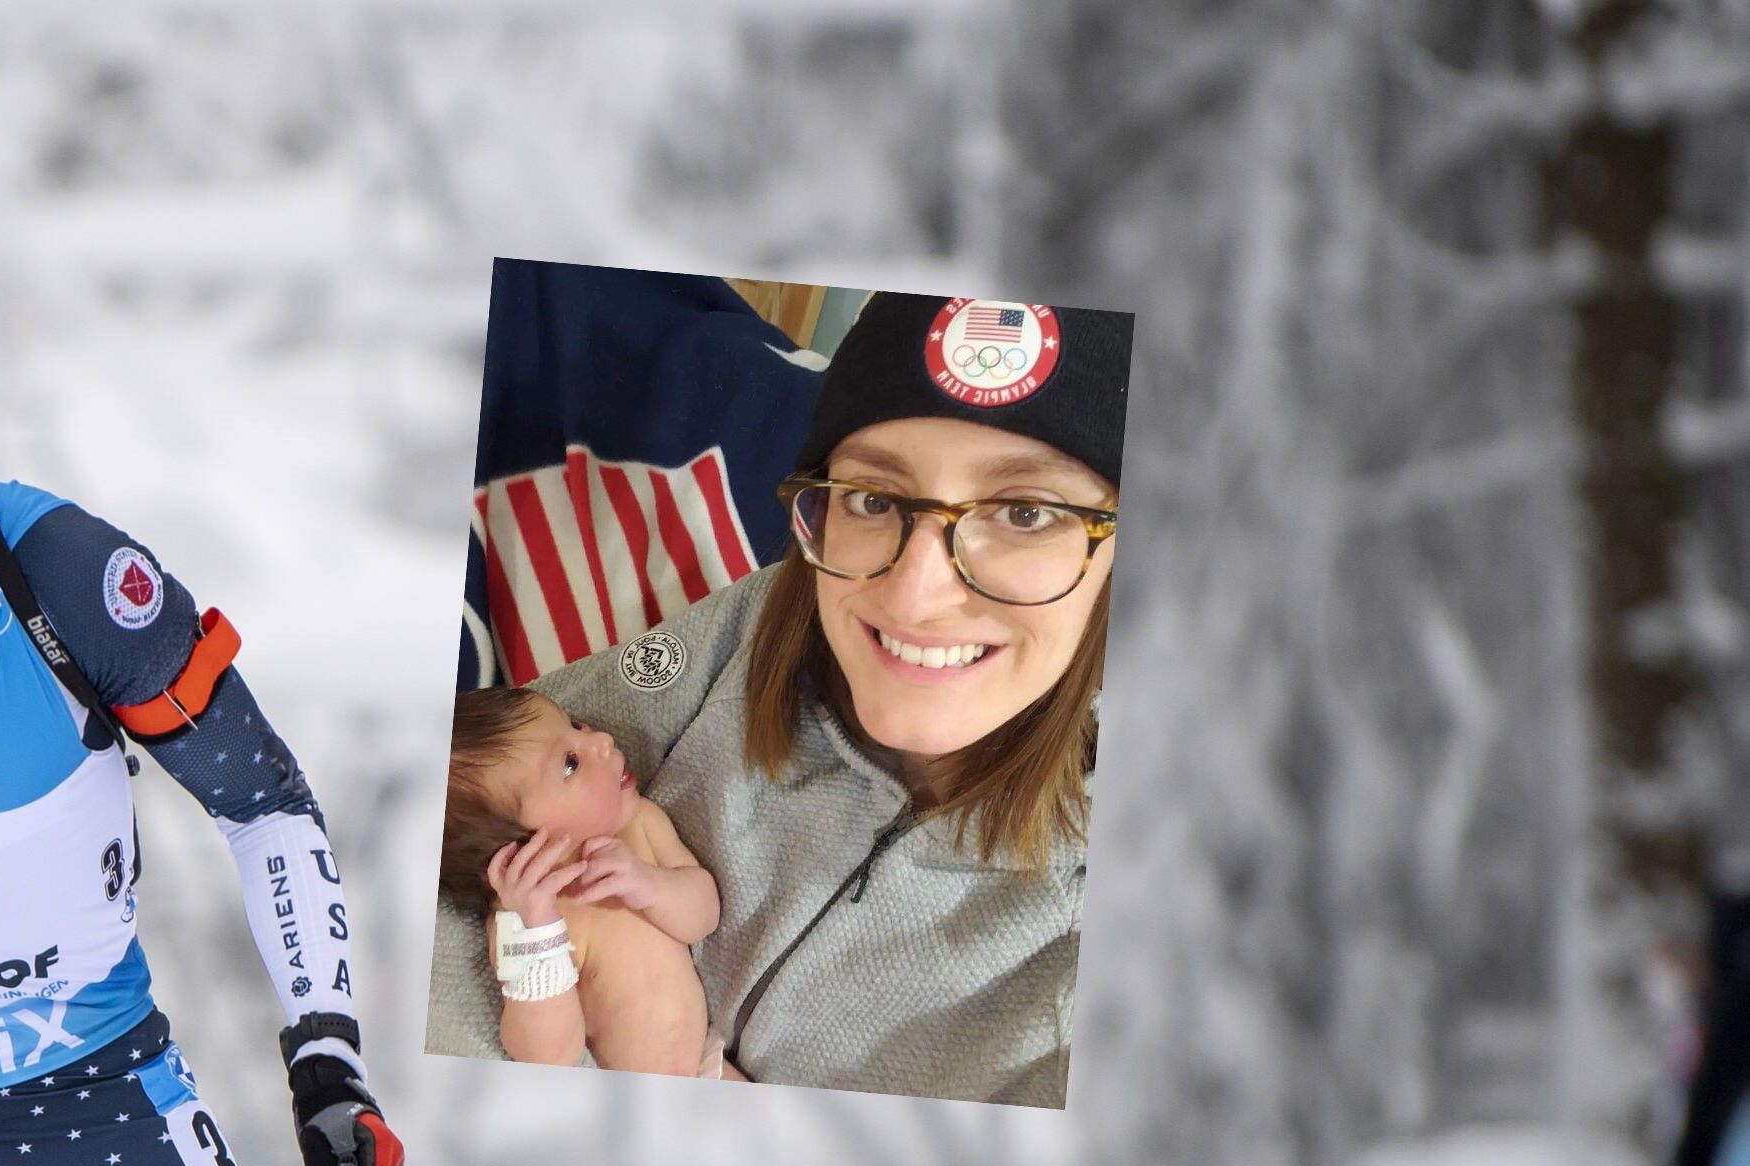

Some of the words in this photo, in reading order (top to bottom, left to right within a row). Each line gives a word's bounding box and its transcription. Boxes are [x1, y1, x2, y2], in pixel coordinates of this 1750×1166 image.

[27, 616, 68, 666] biatar
[101, 838, 126, 901] 3
[267, 855, 304, 969] ARIENS
[310, 849, 352, 999] USA
